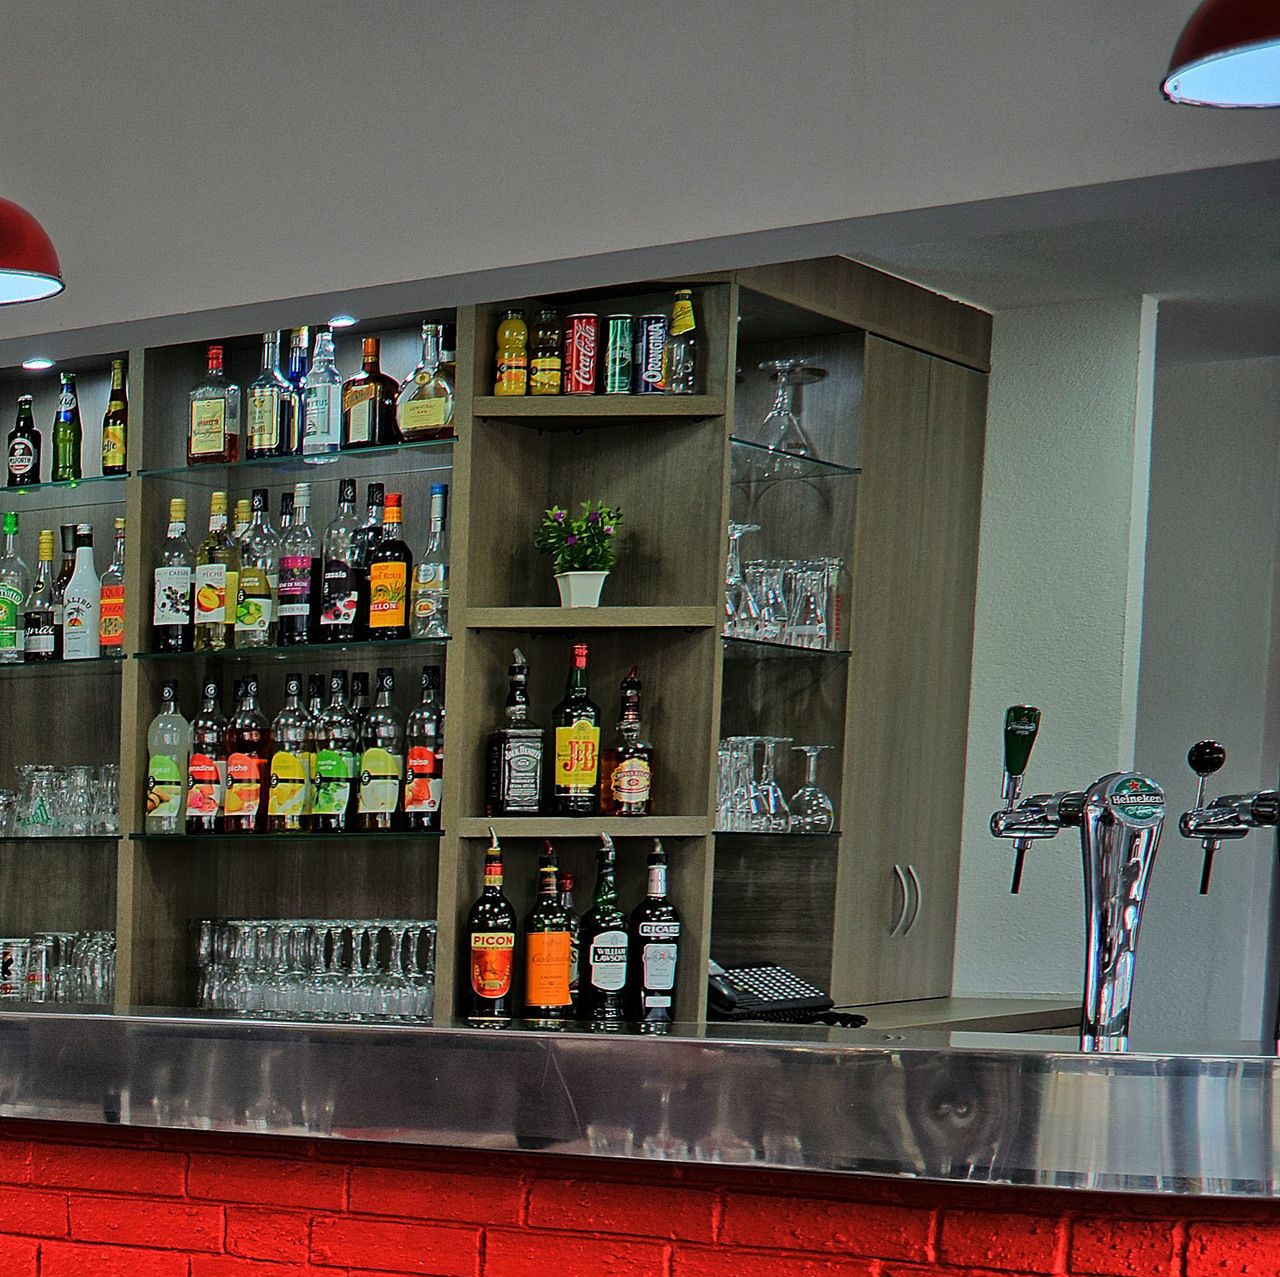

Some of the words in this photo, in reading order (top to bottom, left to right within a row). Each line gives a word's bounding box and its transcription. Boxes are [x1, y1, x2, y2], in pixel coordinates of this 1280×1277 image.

[643, 322, 664, 382] ORANGINA
[1111, 794, 1162, 804] Heineken
[473, 936, 513, 945] PICON
